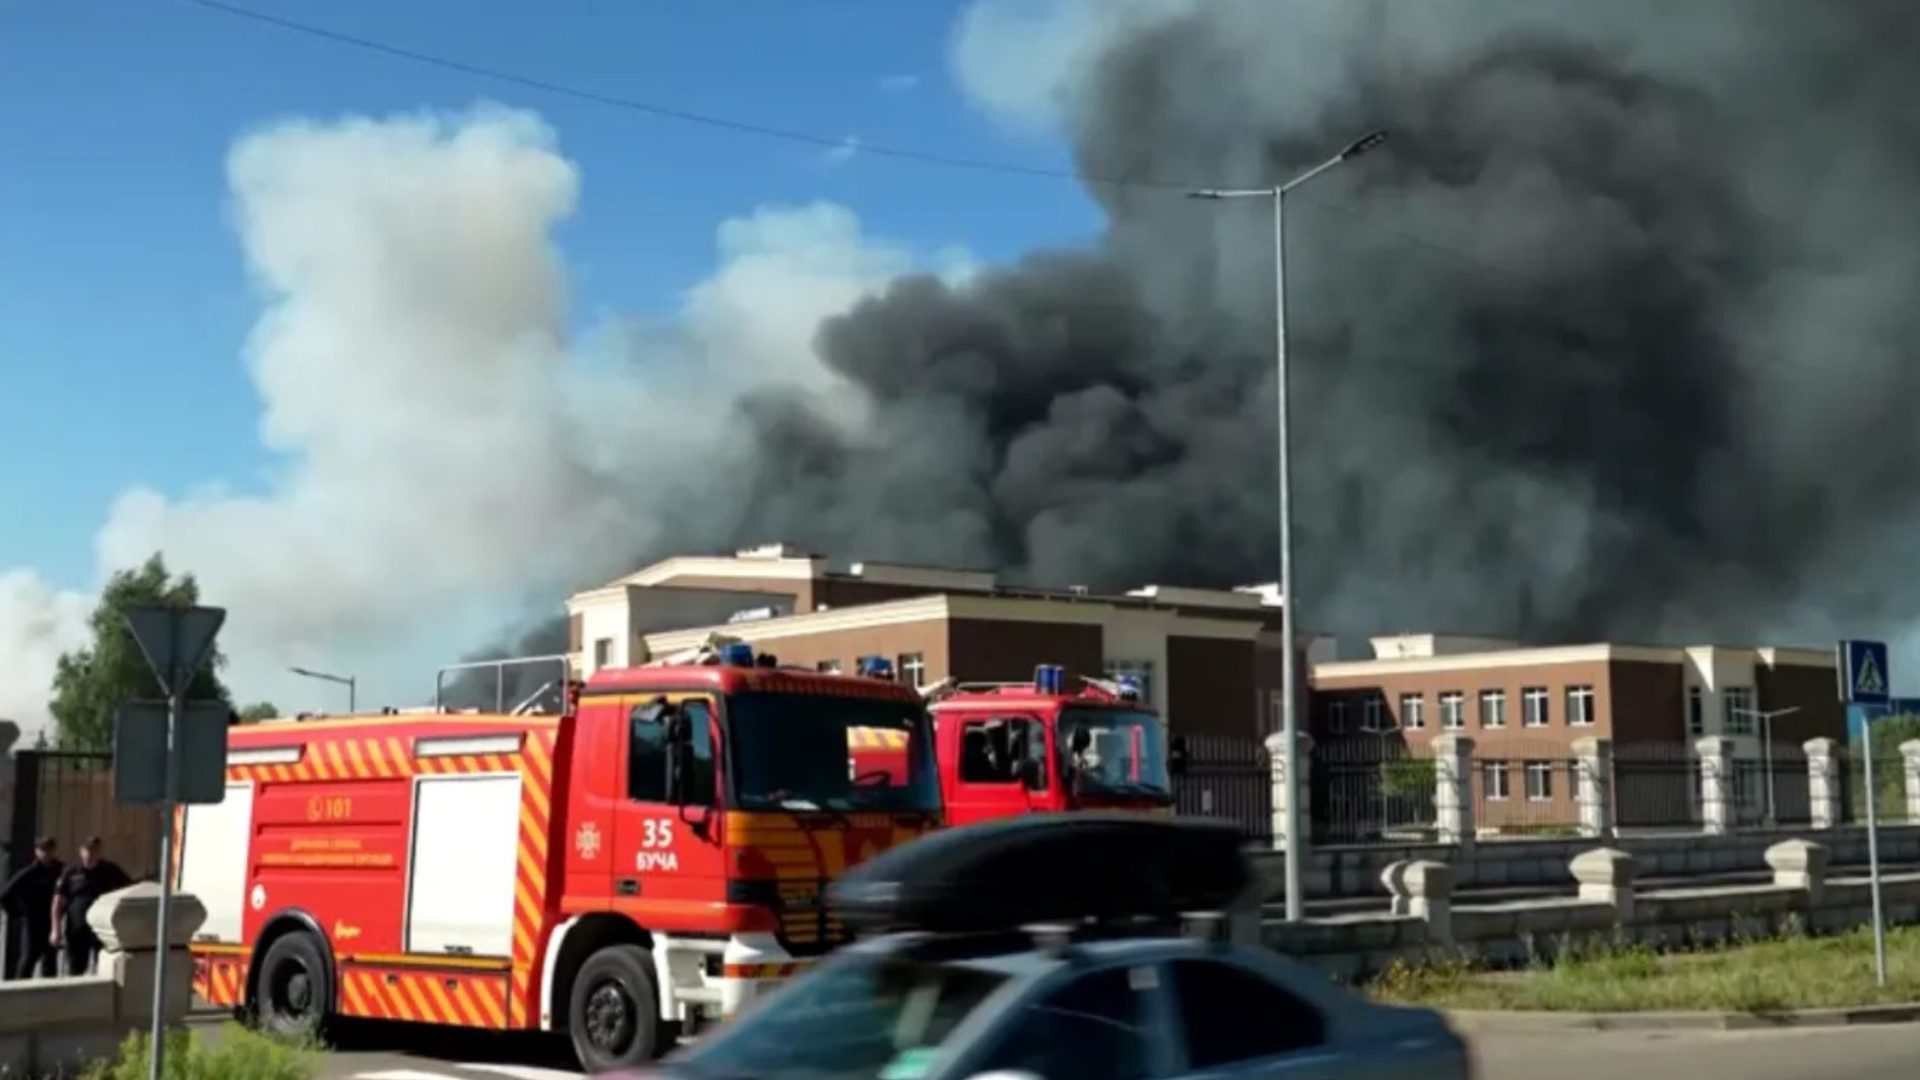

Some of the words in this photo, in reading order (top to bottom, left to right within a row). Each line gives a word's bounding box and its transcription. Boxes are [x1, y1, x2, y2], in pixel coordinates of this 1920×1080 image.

[326, 798, 351, 819] 101
[642, 819, 673, 848] 35
[636, 852, 679, 871] БУЧА
